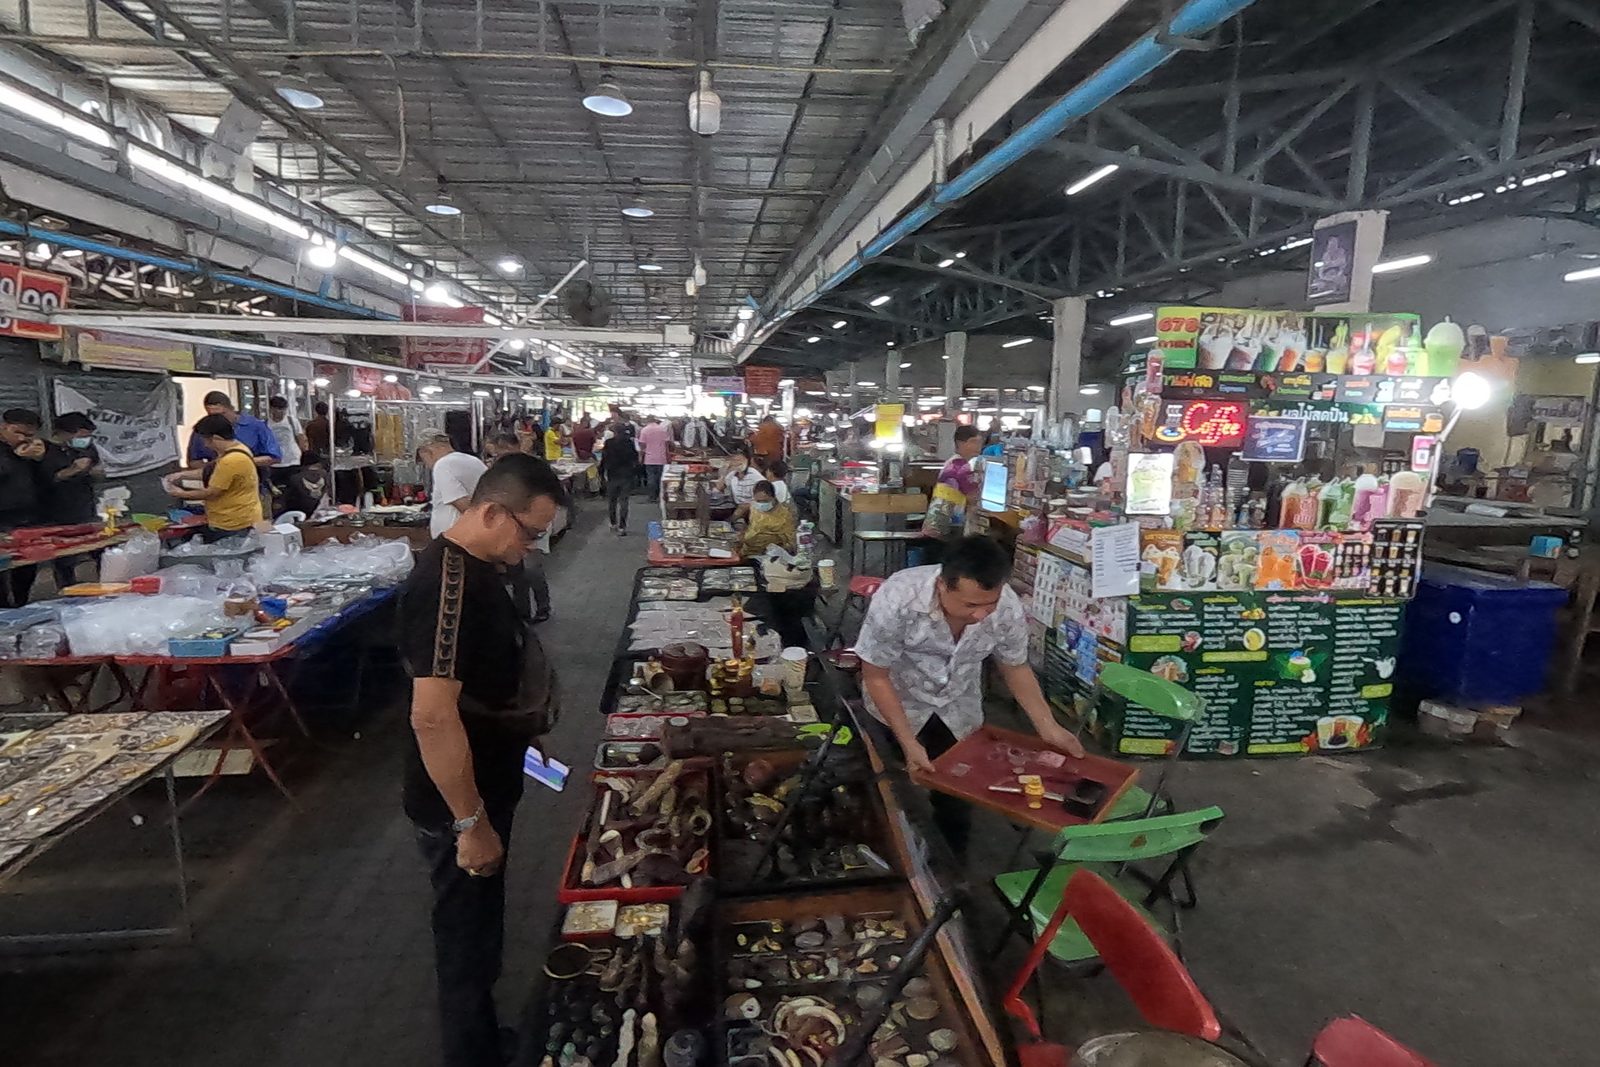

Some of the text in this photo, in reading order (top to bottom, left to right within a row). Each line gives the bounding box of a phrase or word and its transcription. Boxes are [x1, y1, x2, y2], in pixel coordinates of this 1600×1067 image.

[1281, 402, 1349, 422] ผลไม้สดปั่น
